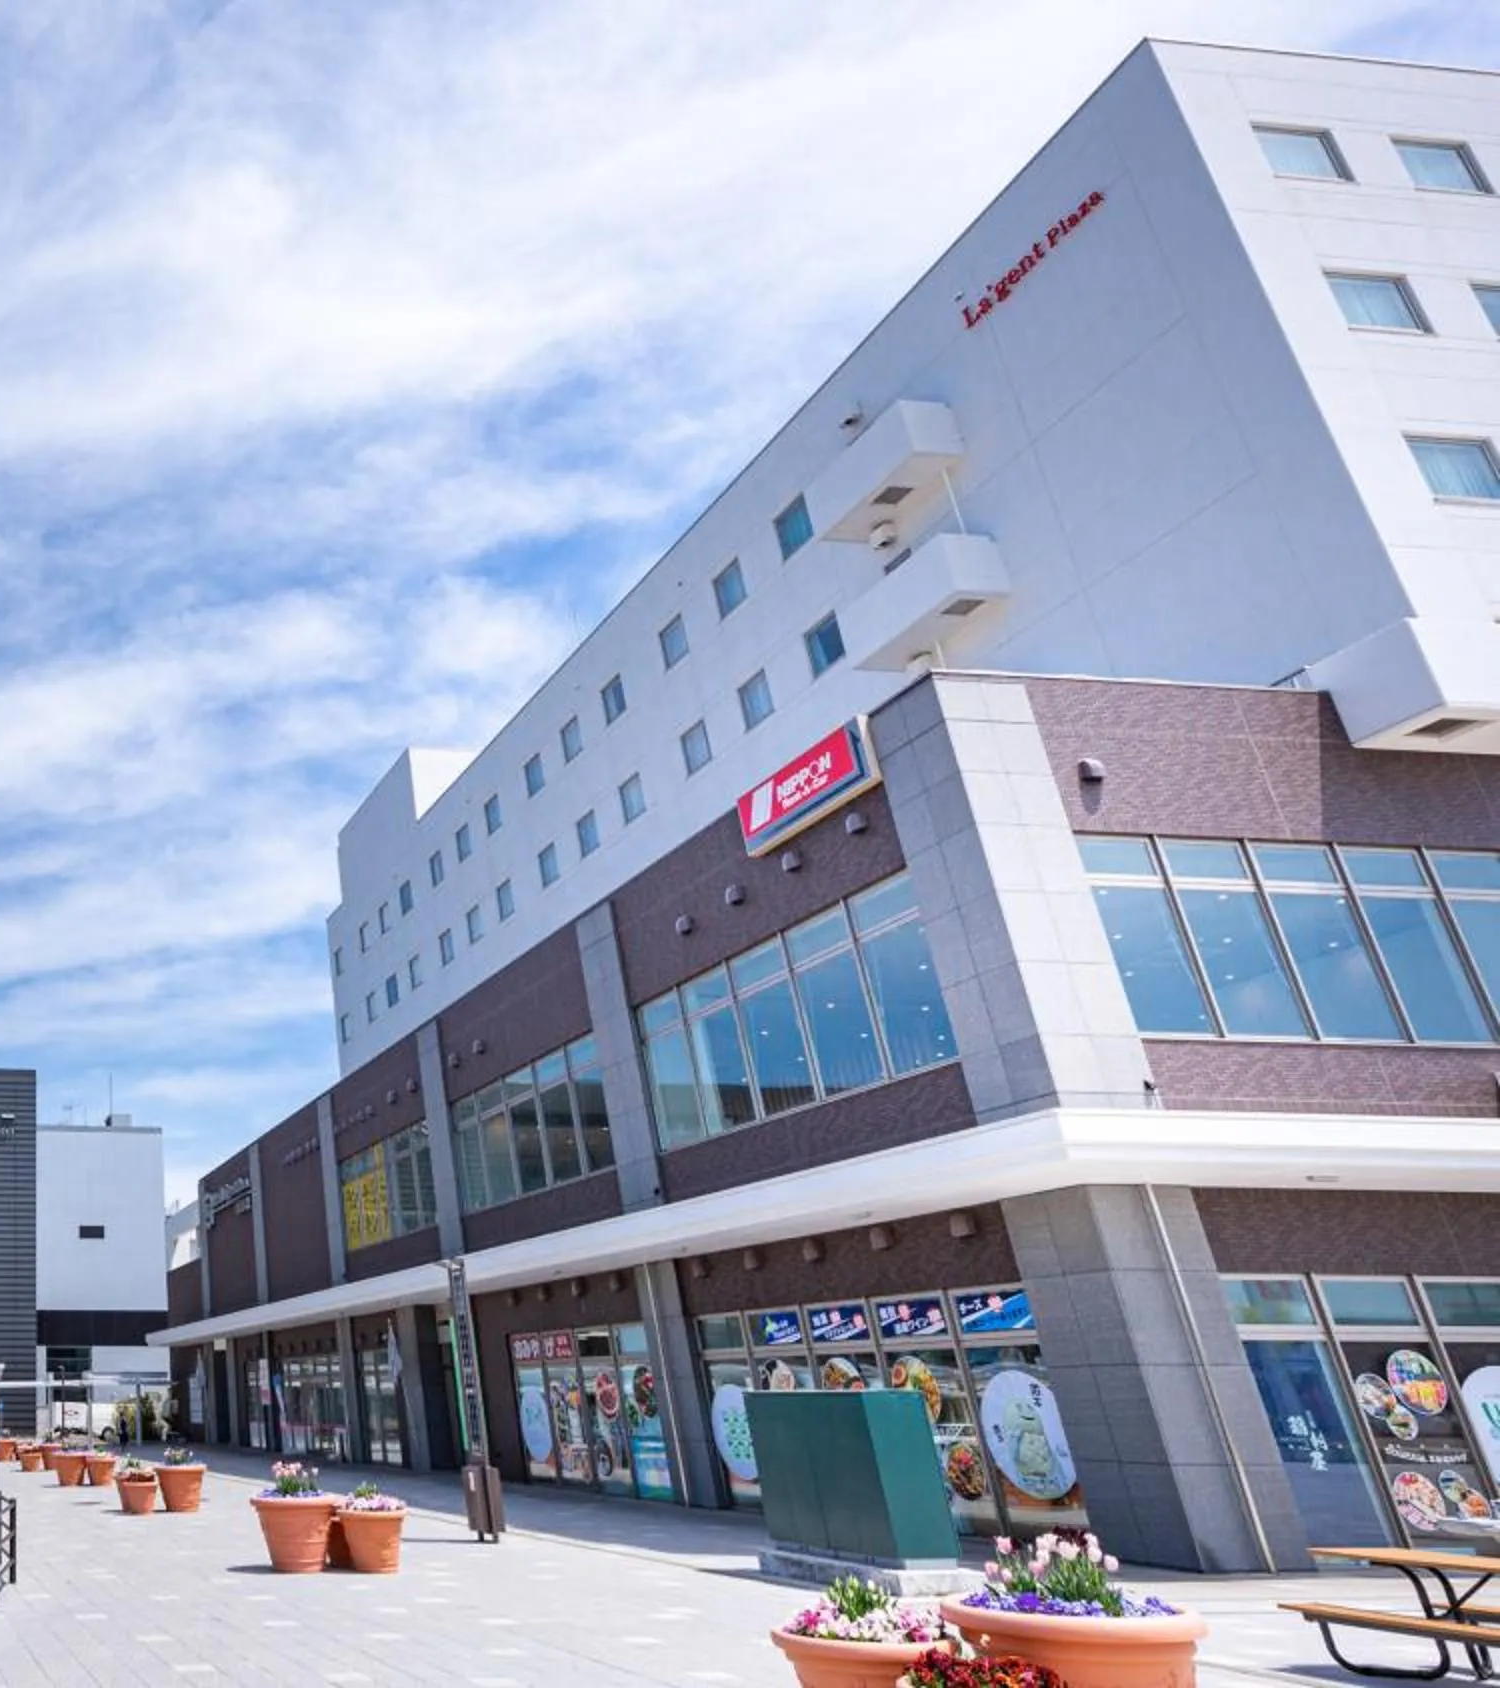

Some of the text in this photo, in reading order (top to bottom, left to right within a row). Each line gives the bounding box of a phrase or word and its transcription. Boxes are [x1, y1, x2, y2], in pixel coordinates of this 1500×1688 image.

[961, 191, 1105, 328] La'gent Plaza
[776, 751, 831, 803] NIPPON
